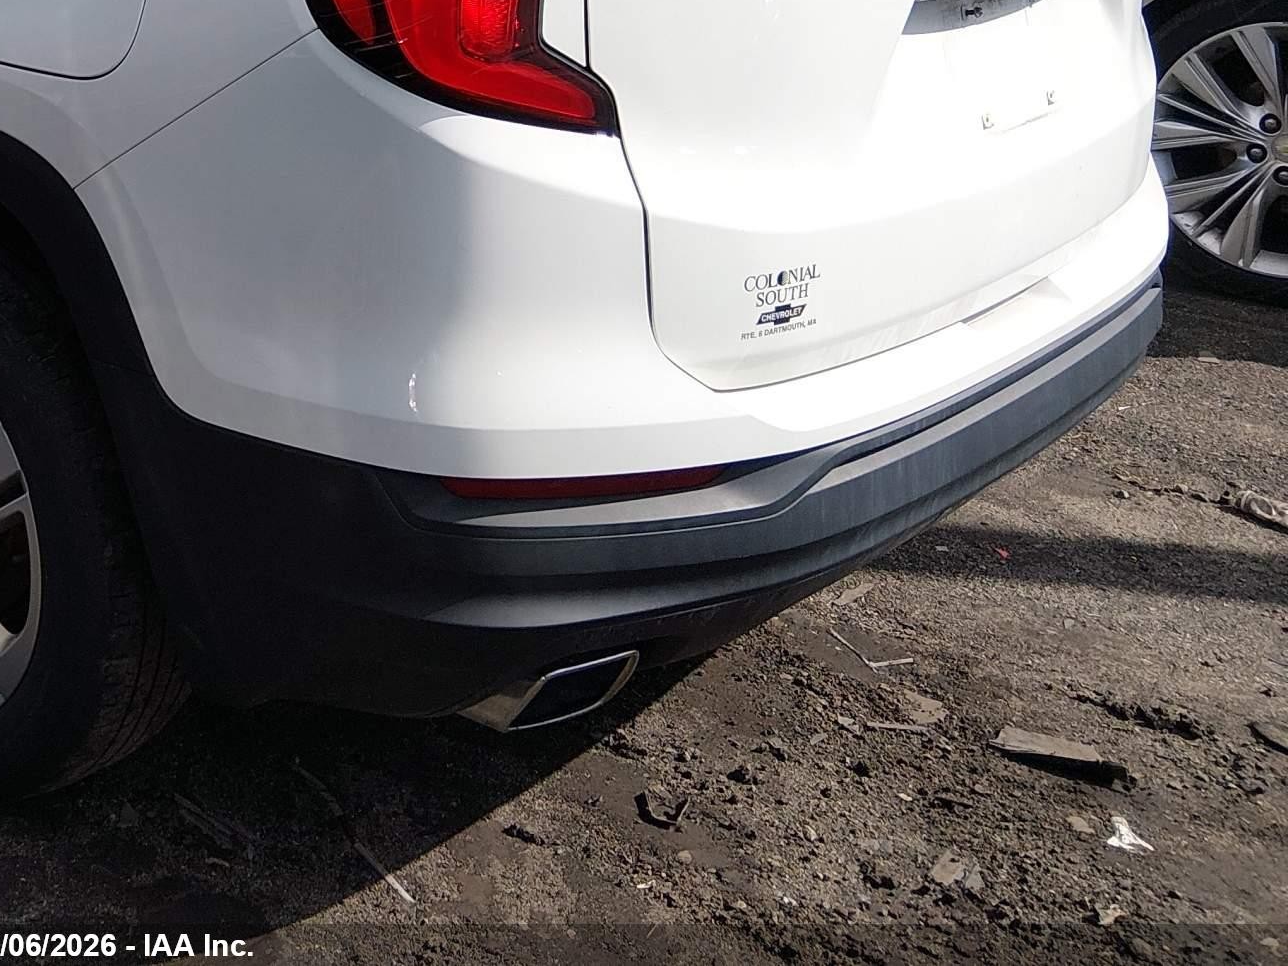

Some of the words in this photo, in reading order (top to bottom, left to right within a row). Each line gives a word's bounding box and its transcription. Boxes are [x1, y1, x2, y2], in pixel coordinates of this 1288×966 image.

[744, 264, 821, 292] COLONIAL
[755, 282, 809, 308] SOUTH
[761, 305, 803, 323] CHEVROLET
